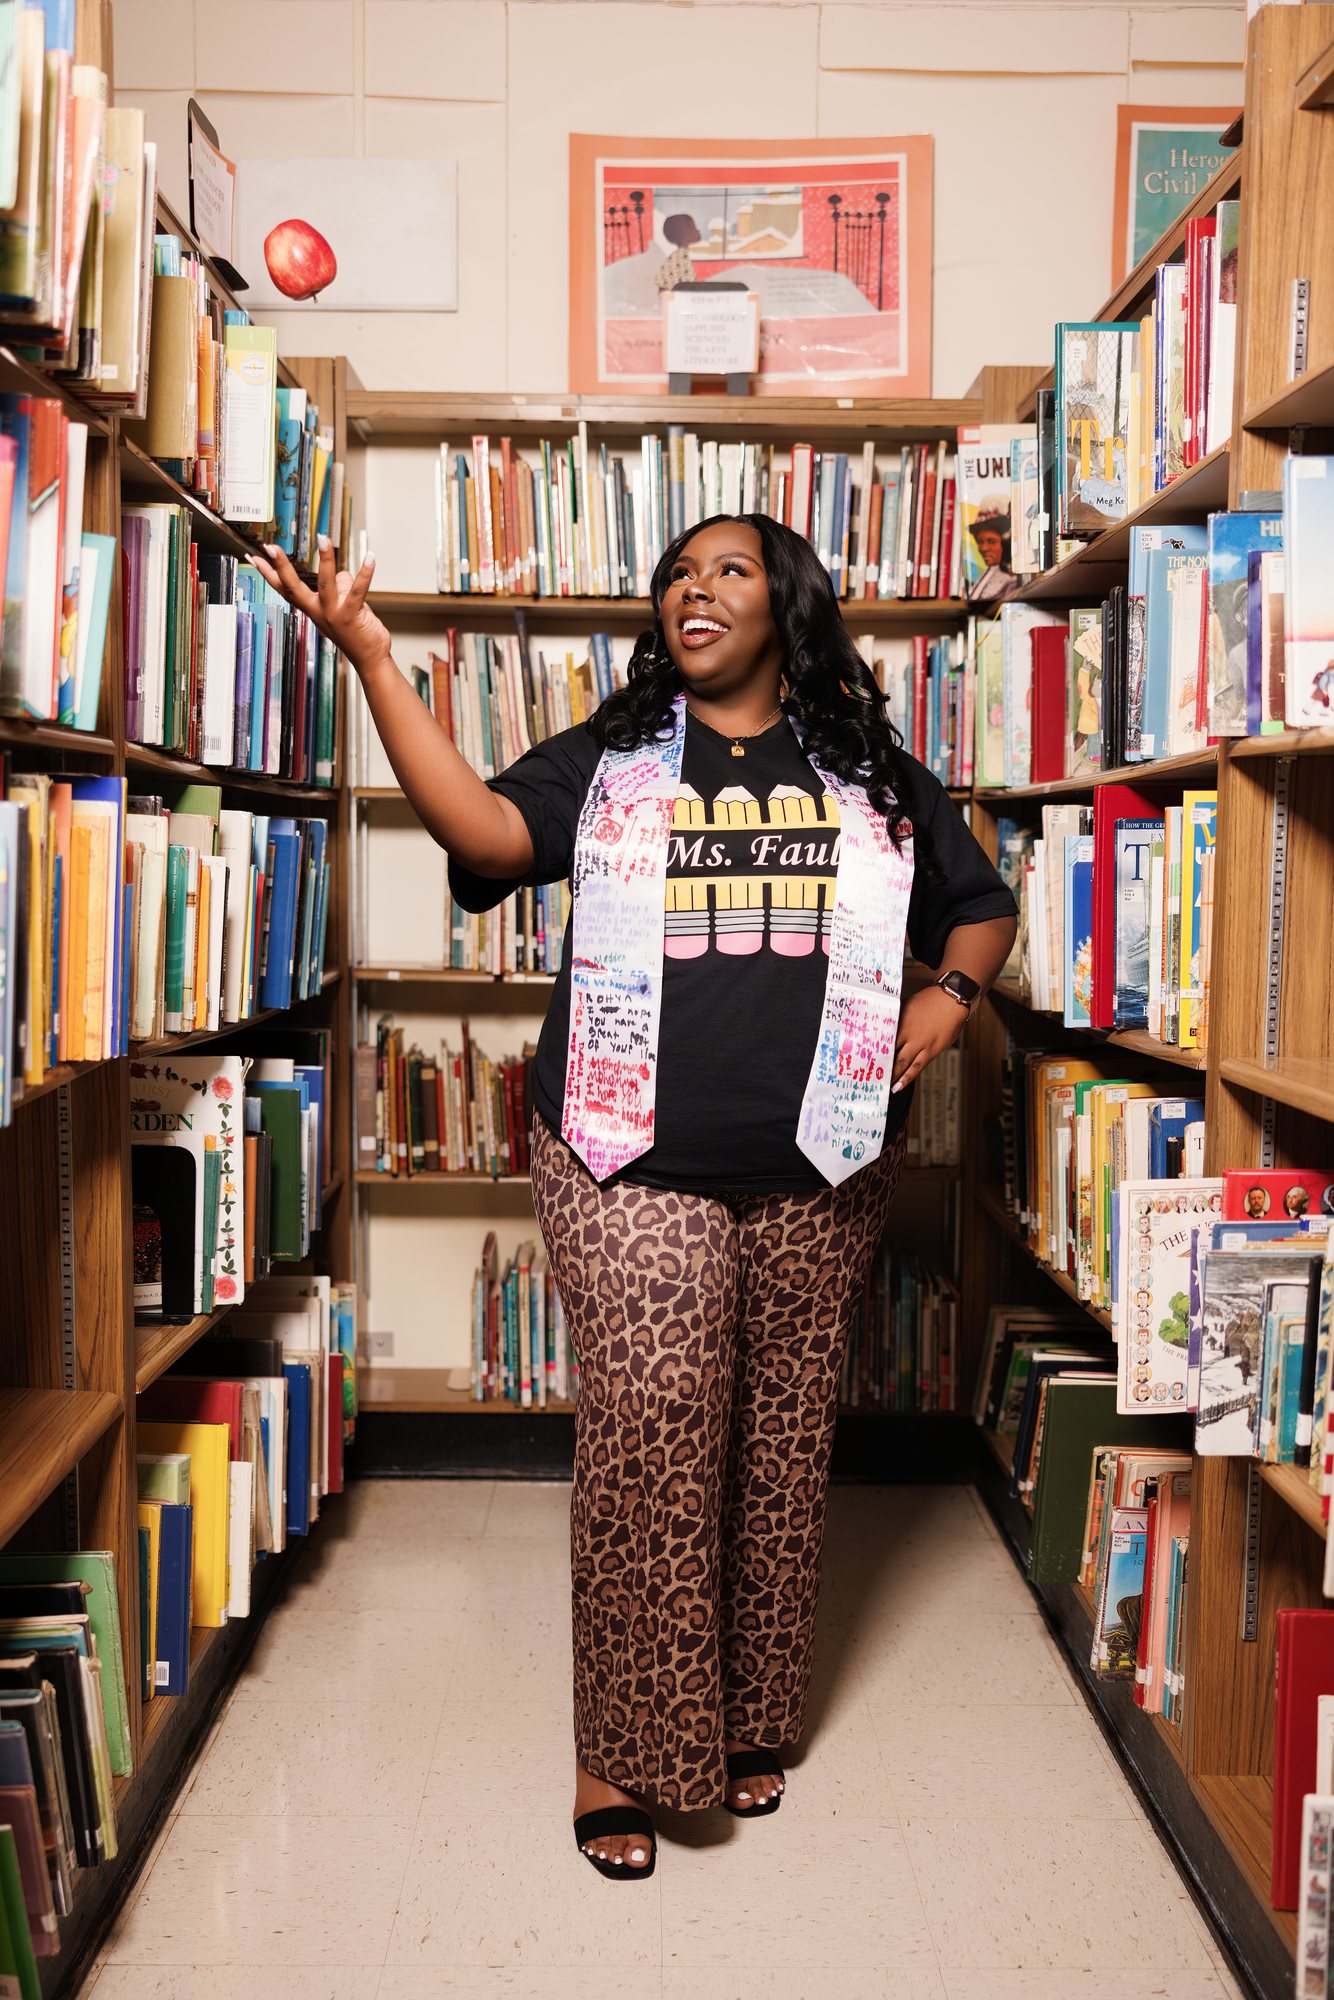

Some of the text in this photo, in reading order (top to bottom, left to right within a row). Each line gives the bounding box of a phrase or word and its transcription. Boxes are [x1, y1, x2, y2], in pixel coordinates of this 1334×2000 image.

[1143, 170, 1197, 195] Civil
[683, 314, 746, 323] TECHNOLOGY
[964, 458, 975, 479] THE
[1096, 496, 1114, 508] Meg
[1167, 556, 1187, 568] THE
[664, 834, 733, 870] Ms.
[133, 1082, 173, 1099] FIRST
[131, 1113, 194, 1132] RDEN
[1159, 1229, 1189, 1251] THE
[1161, 1344, 1176, 1354] THE
